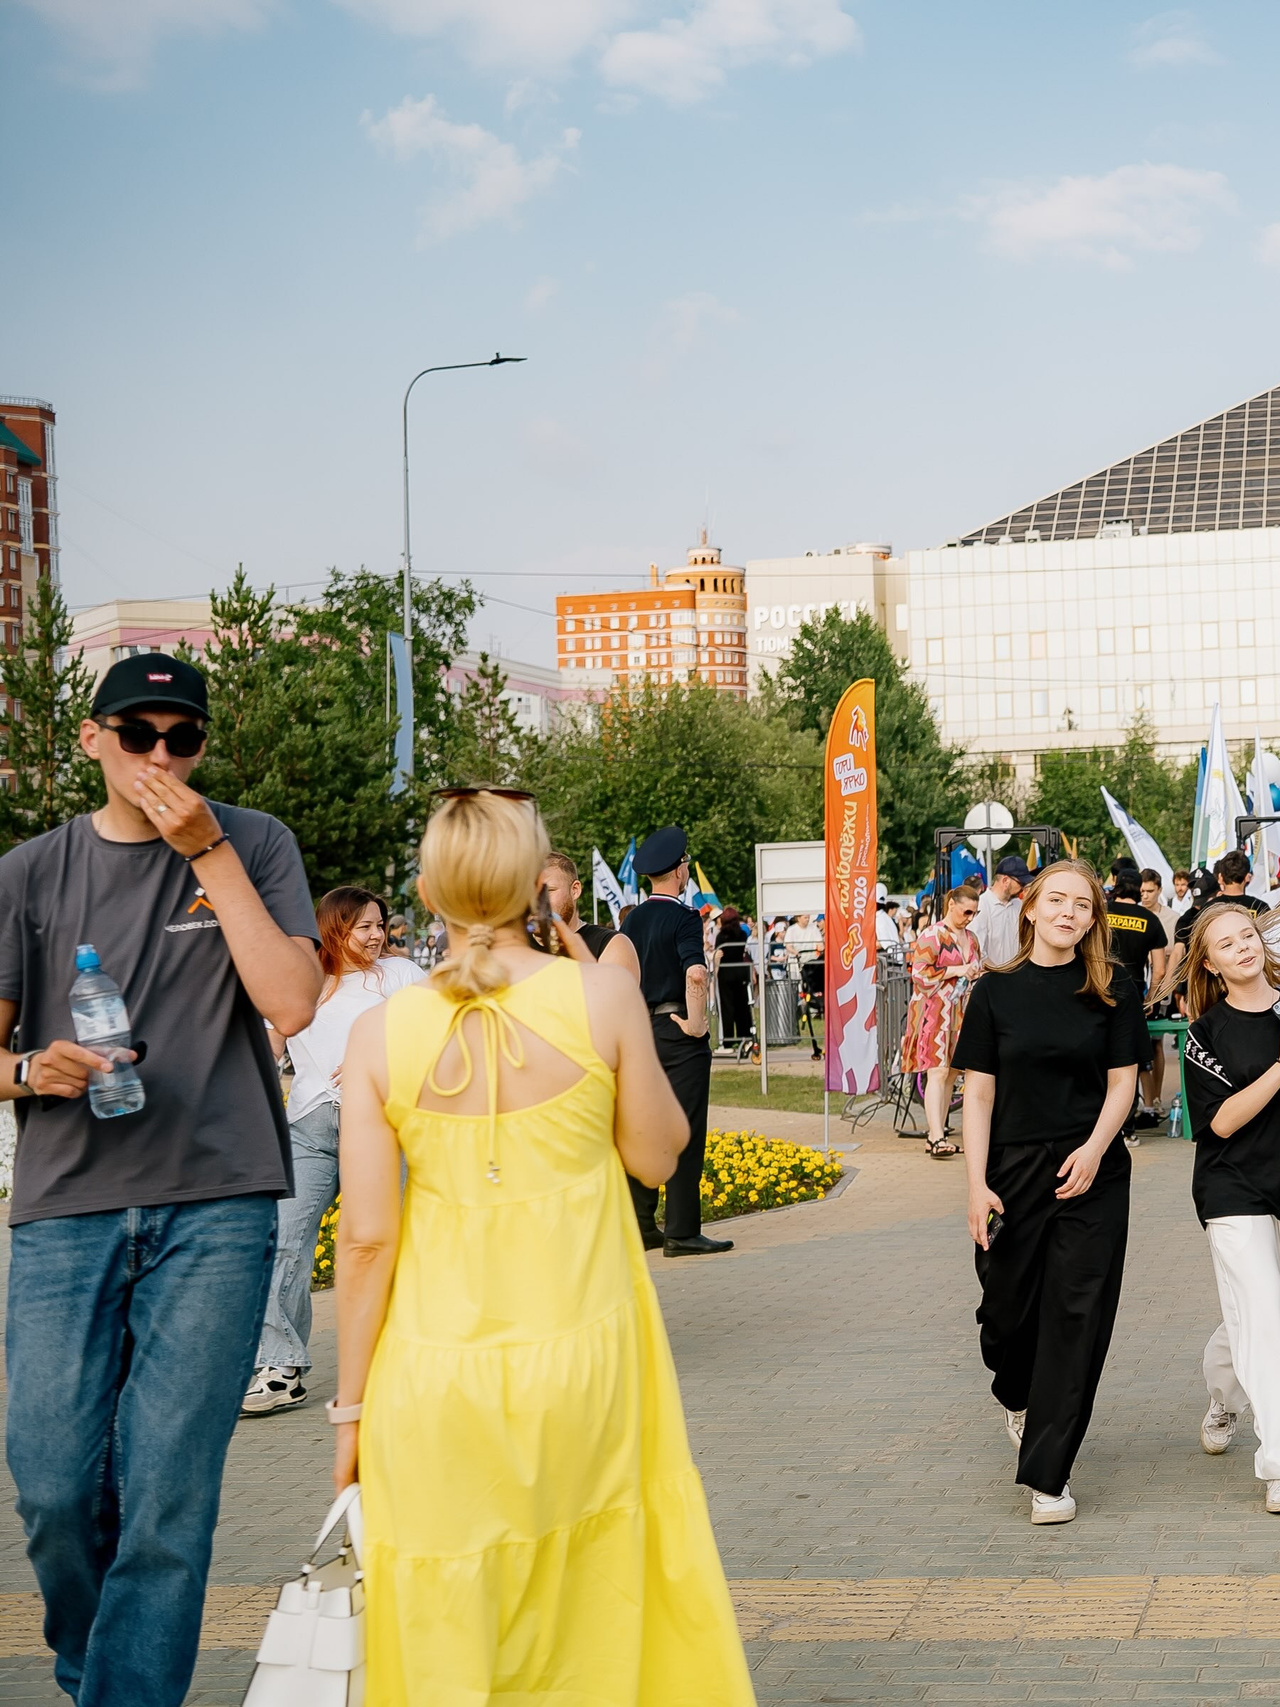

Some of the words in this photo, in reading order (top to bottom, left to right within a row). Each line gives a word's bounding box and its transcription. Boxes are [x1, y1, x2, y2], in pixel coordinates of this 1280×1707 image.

[835, 758, 852, 776] ГОРИ
[843, 772, 866, 791] ЯРКО
[853, 876, 868, 919] 2026
